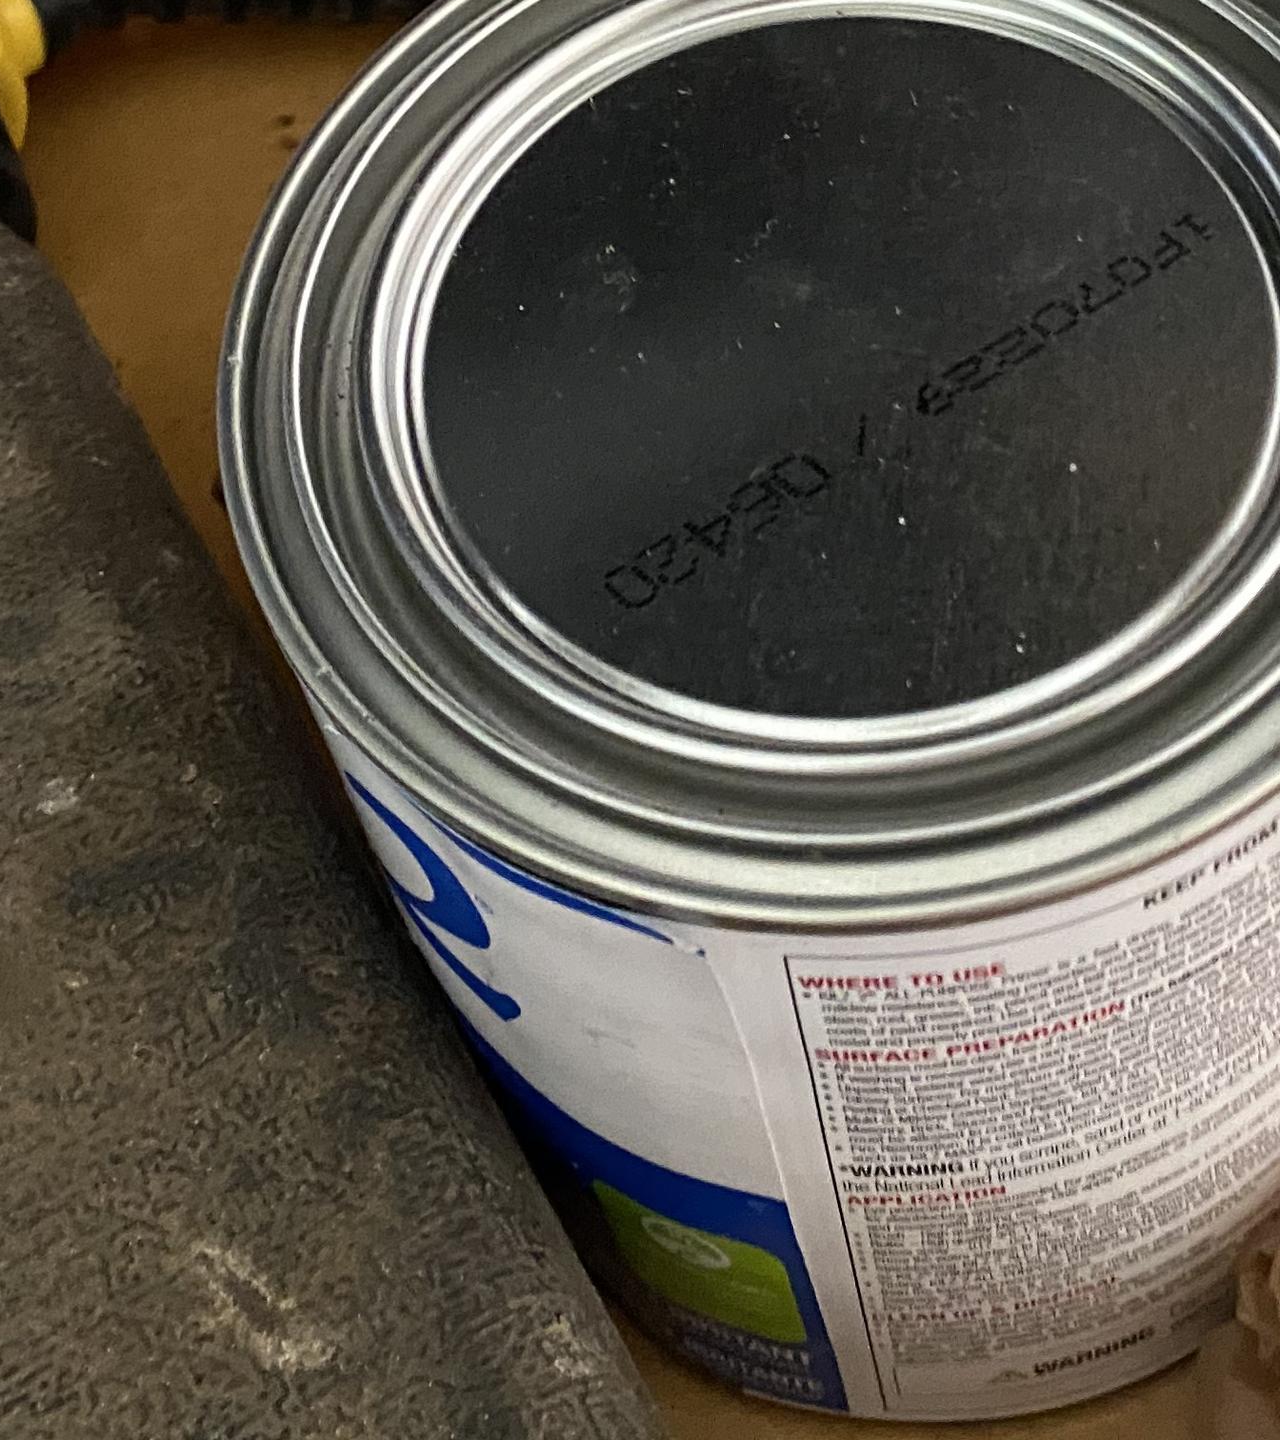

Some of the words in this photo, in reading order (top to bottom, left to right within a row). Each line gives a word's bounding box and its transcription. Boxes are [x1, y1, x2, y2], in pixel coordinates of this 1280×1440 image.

[797, 974, 899, 991] WHERE
[911, 971, 944, 988] TO
[953, 961, 1006, 984] USE
[815, 1045, 938, 1063] SURFACE
[946, 1000, 1127, 1059] PREPARATION
[849, 1161, 964, 1179] WARNING
